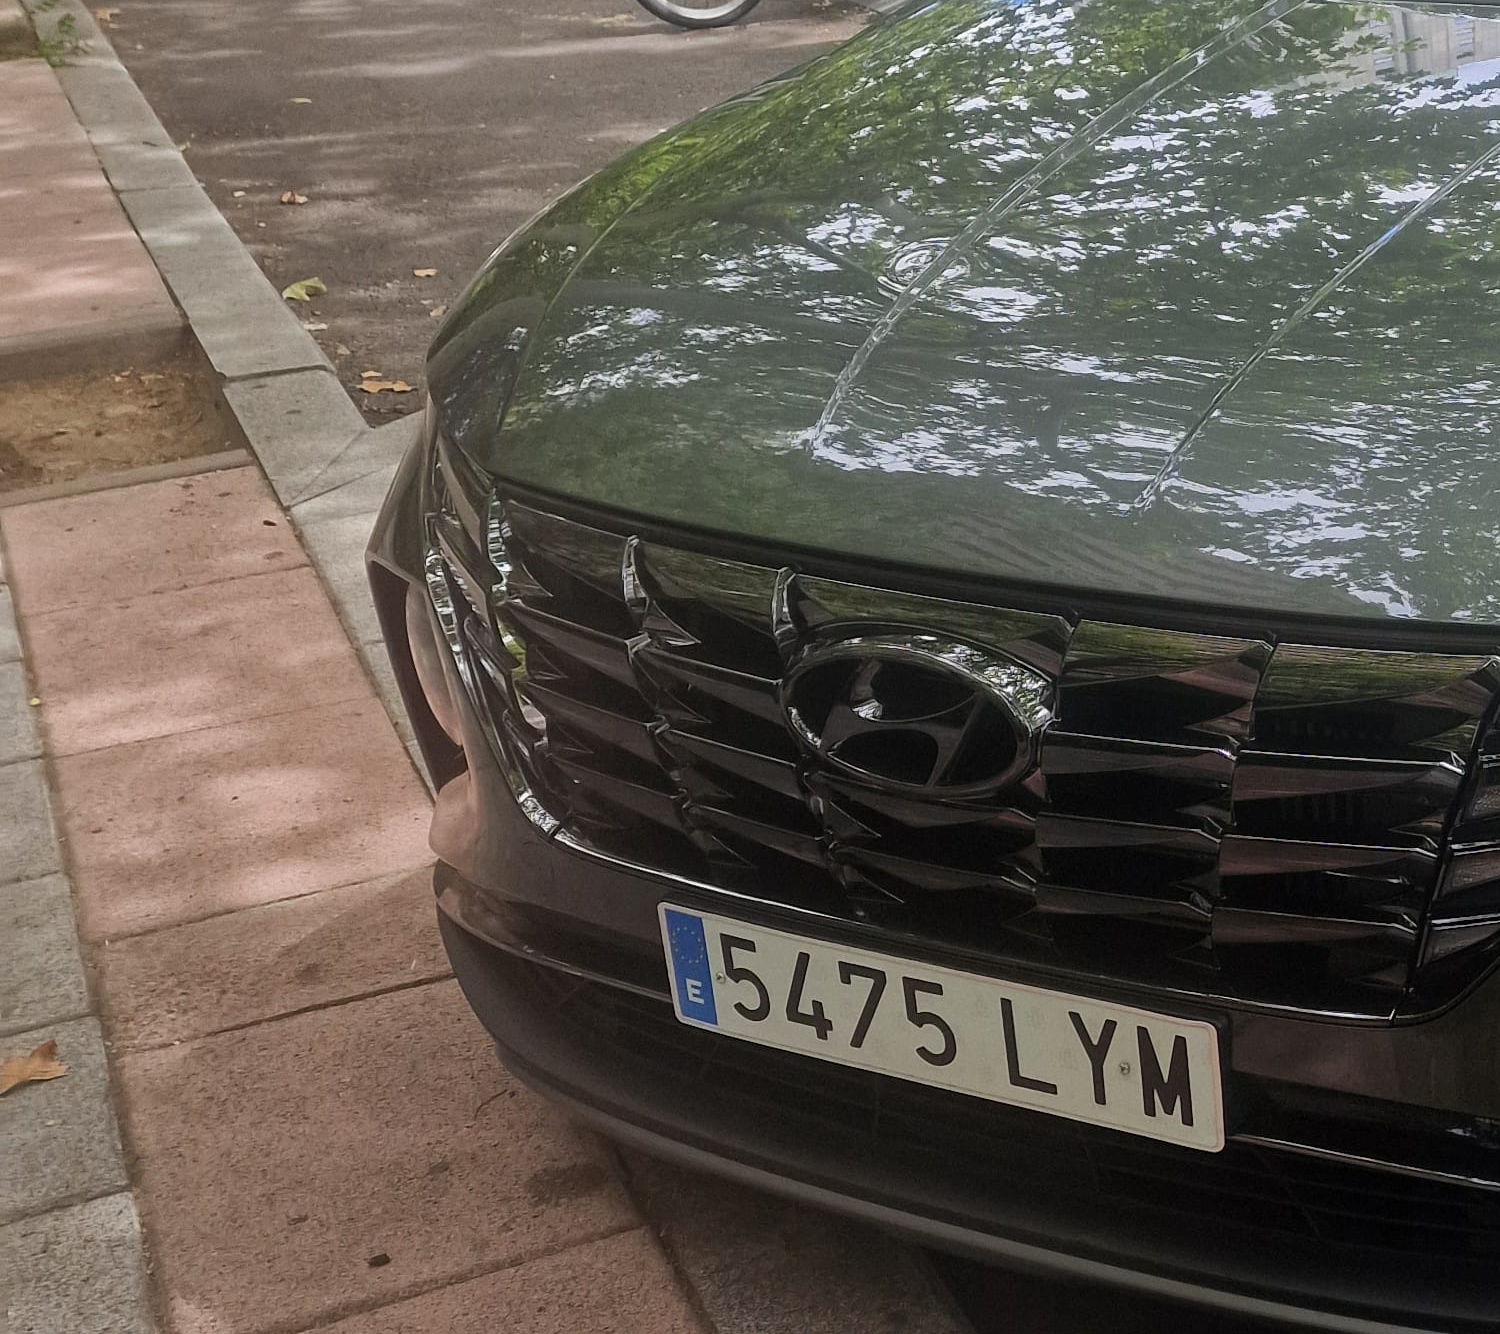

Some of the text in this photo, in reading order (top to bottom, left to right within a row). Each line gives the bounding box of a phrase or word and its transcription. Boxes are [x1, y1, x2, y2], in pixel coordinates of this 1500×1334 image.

[686, 933, 1194, 1127] E 5475 LYM
